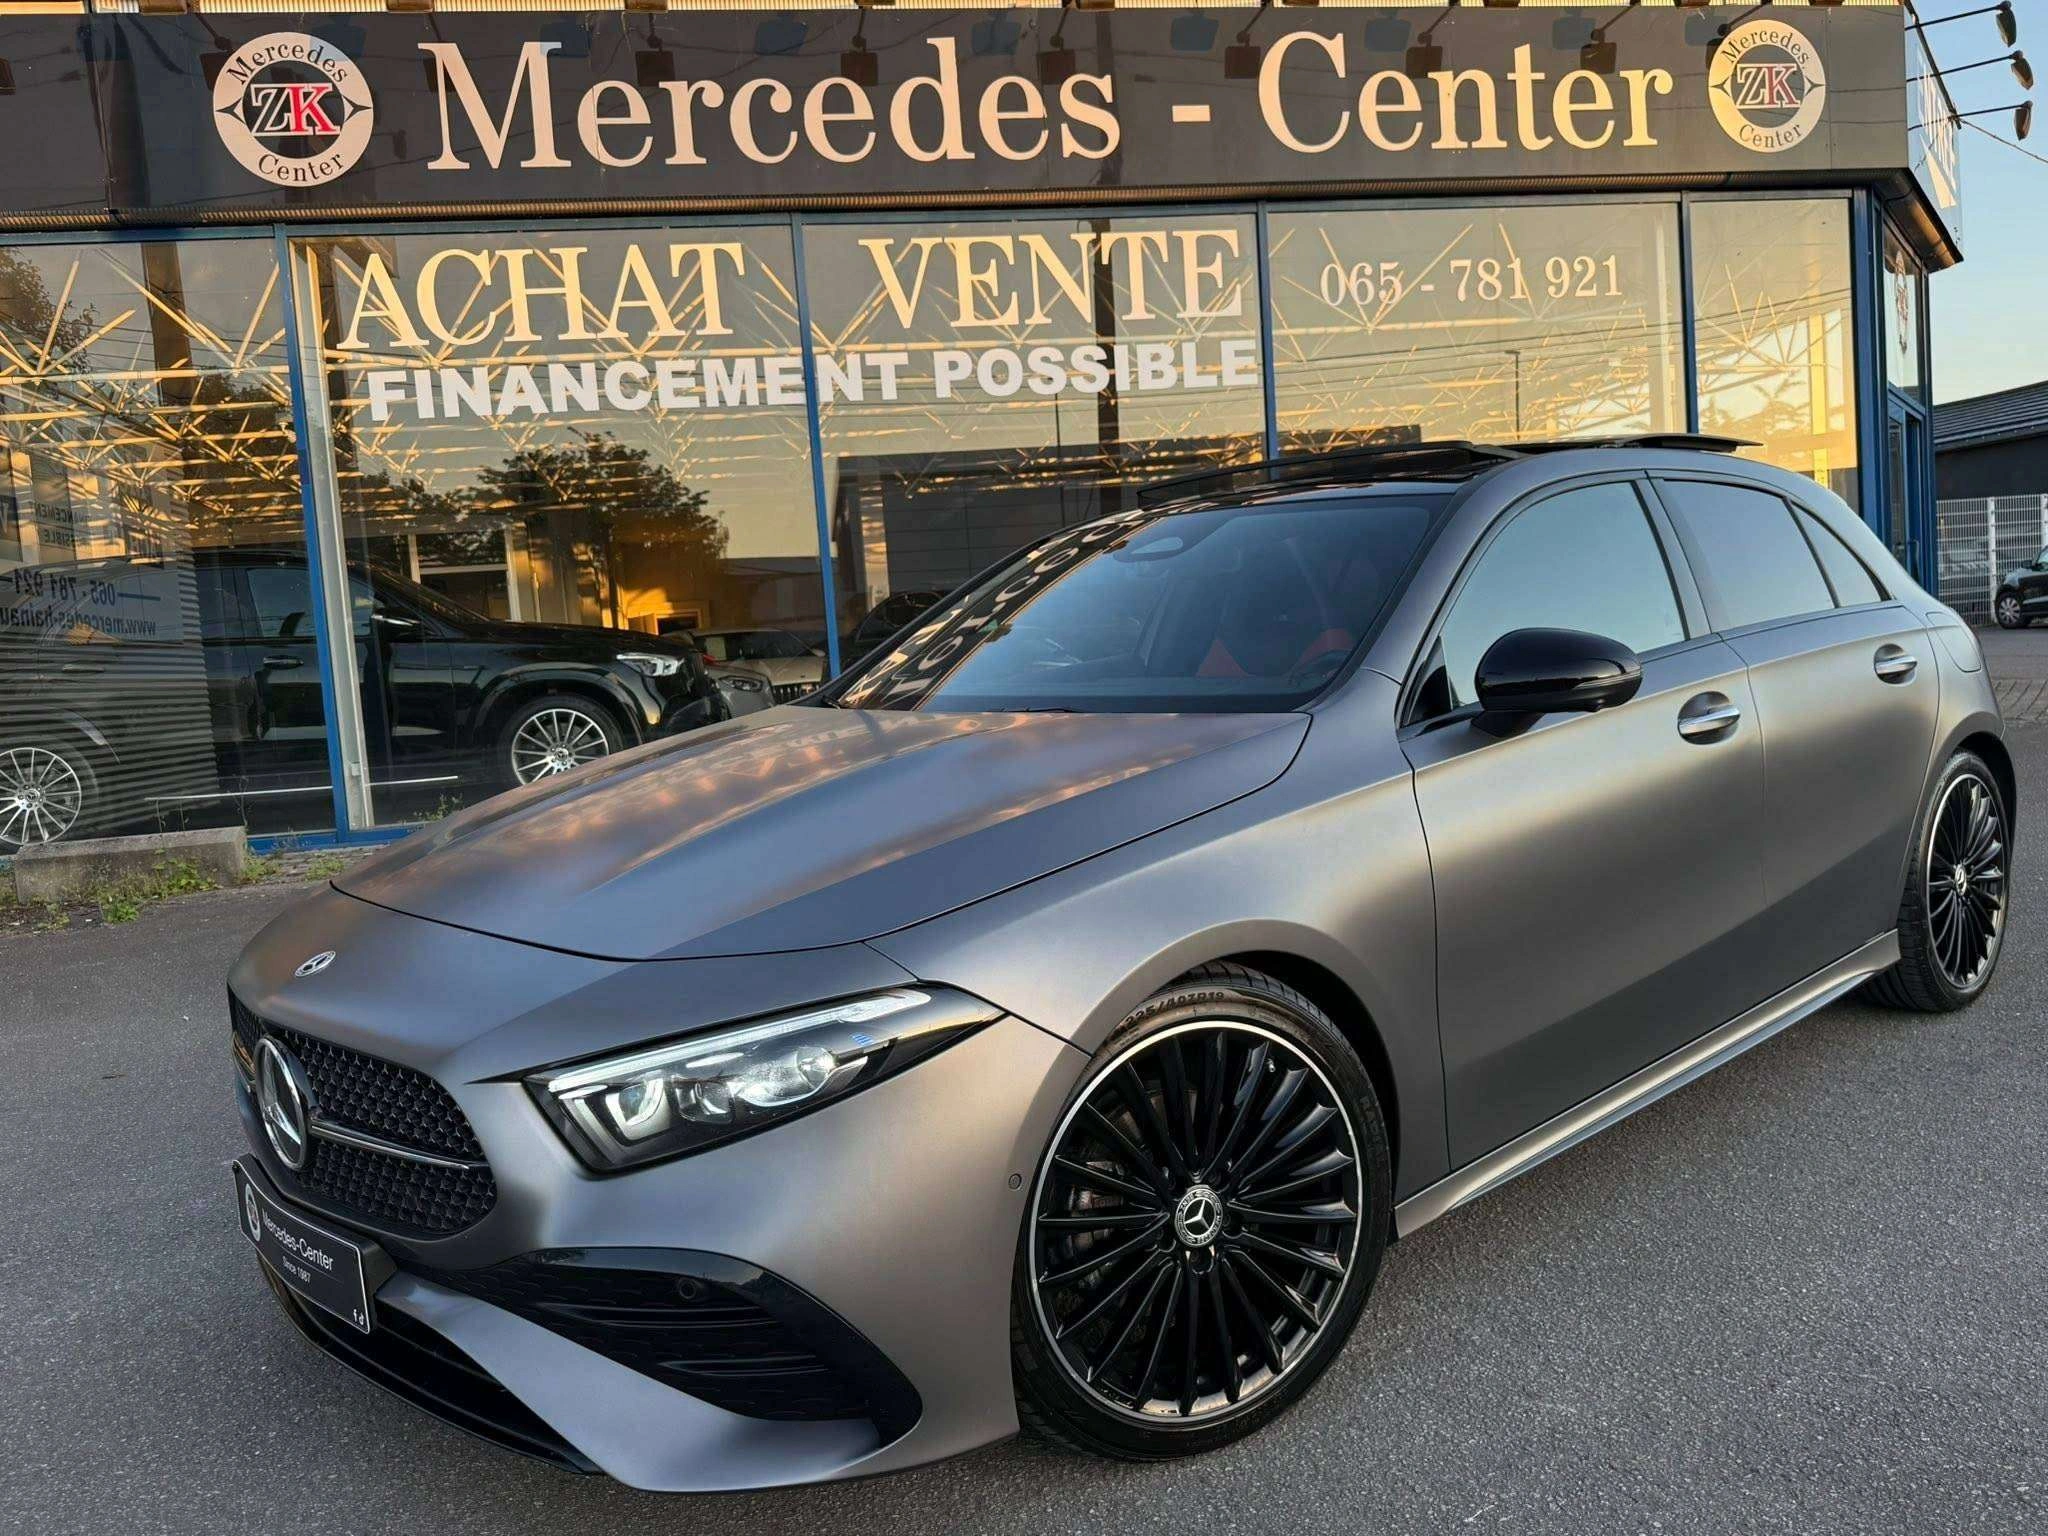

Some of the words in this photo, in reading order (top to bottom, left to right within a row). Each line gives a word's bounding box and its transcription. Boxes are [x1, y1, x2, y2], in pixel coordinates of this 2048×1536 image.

[226, 43, 349, 86] Mercedes
[1720, 30, 1810, 65] Mercedes
[250, 83, 341, 137] ZK
[418, 36, 1121, 172] Mercedes
[1172, 104, 1211, 123] -
[1258, 30, 1674, 154] Center
[1736, 63, 1801, 110] ZK
[1739, 123, 1802, 148] Center
[258, 153, 345, 183] Center
[336, 242, 746, 350] ACHAT
[858, 228, 1242, 329] VENTE
[1320, 261, 1403, 307] 065
[1449, 257, 1530, 302] 781
[1544, 254, 1623, 299] 921
[367, 350, 909, 422] FINANCEMENT
[933, 338, 1258, 399] POSSIBLE
[262, 1207, 334, 1271] Mercedes-Center
